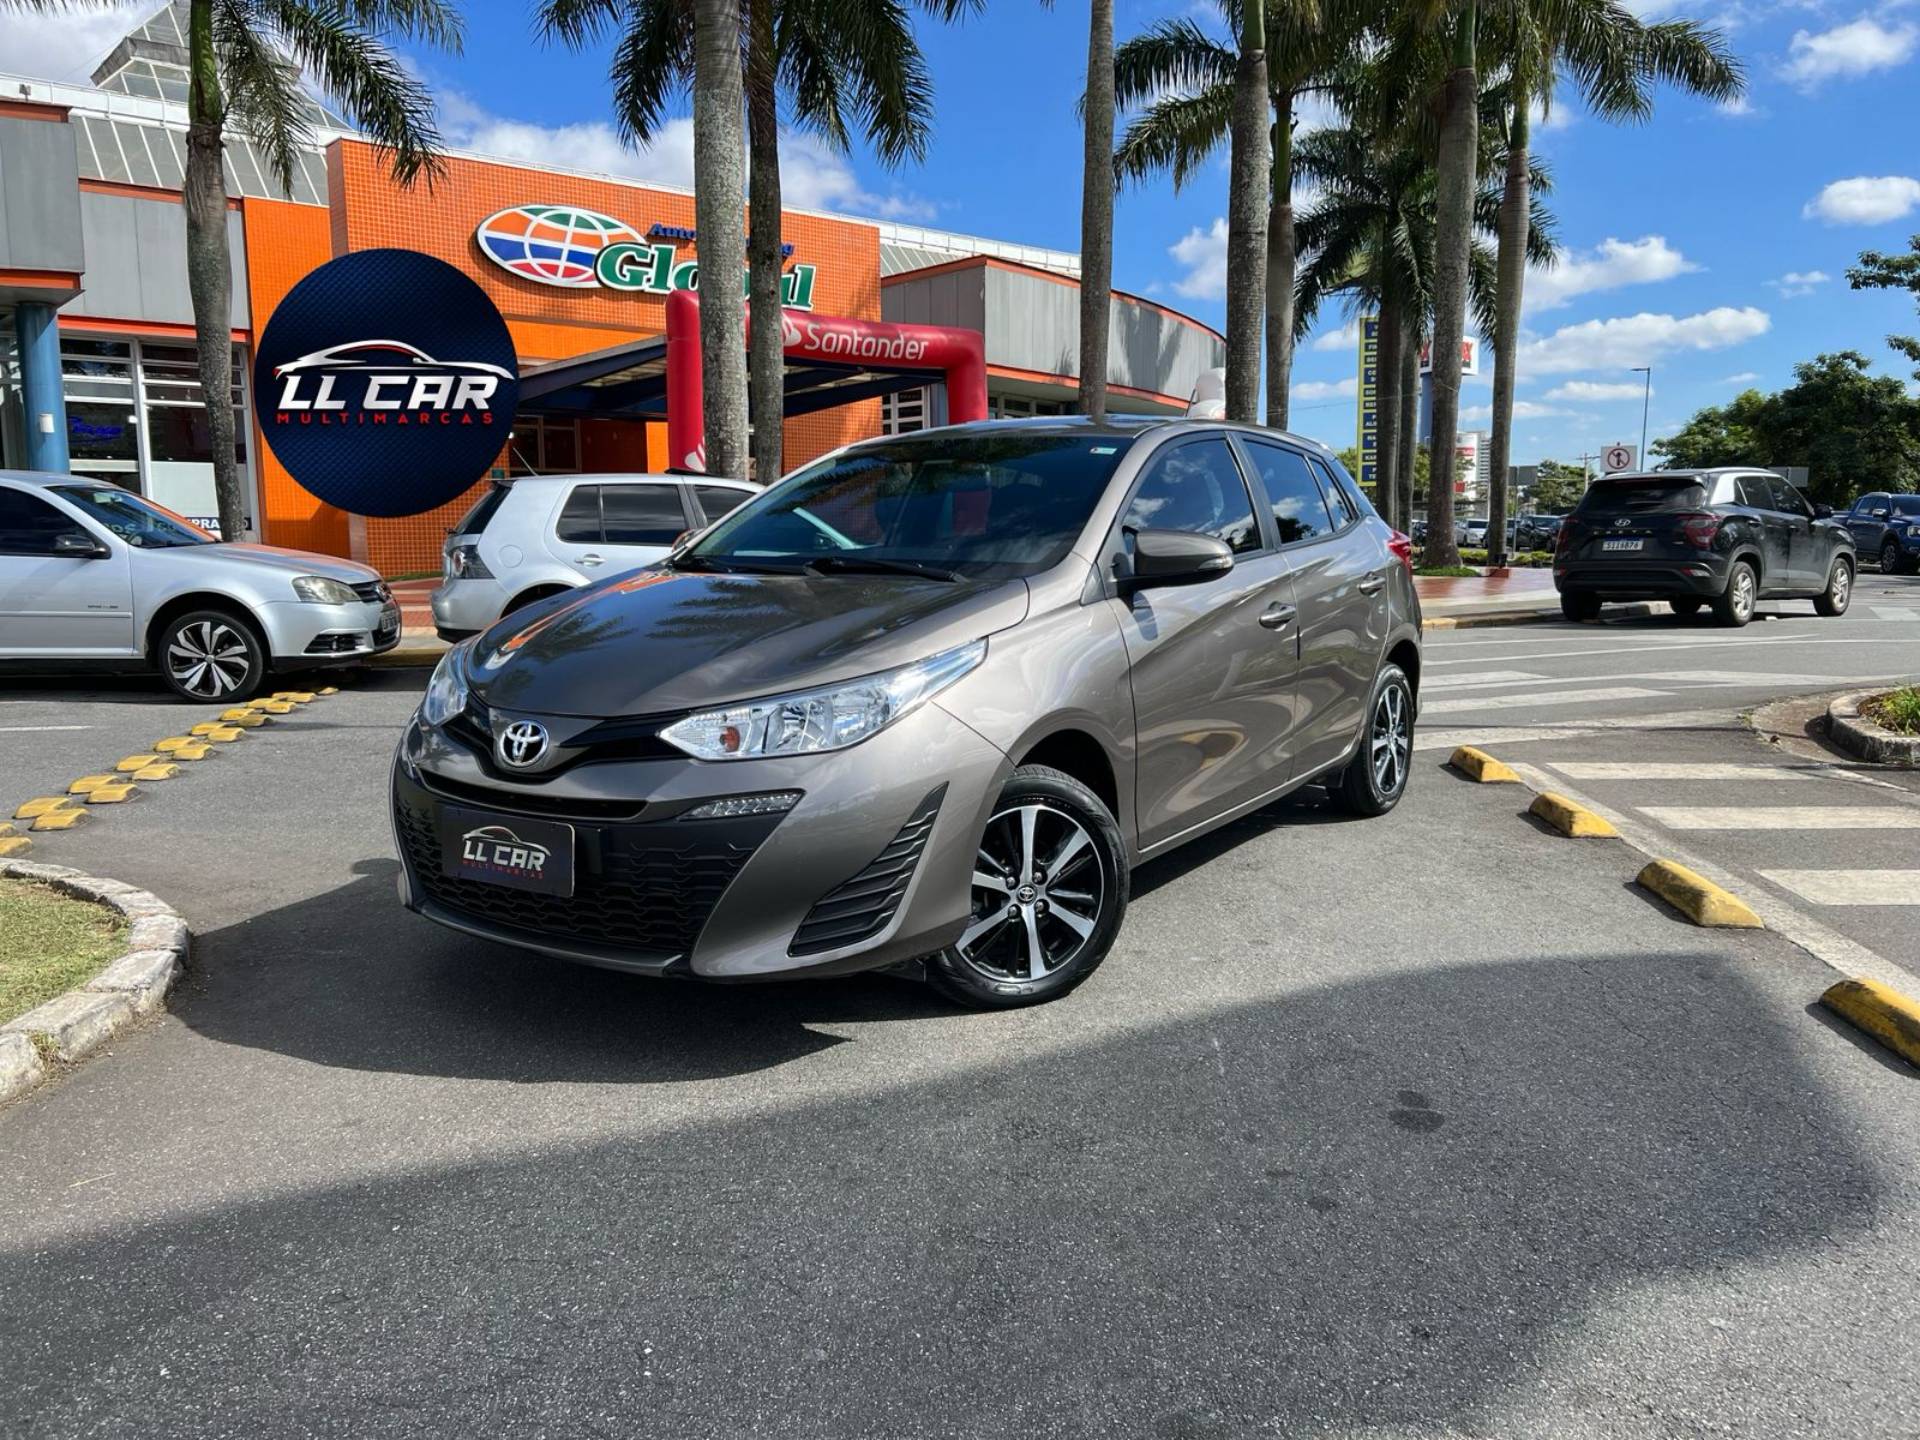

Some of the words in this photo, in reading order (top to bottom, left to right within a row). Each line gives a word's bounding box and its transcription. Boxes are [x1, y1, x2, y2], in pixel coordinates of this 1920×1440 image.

[595, 242, 817, 312] Glol
[804, 323, 929, 360] Santander
[463, 840, 488, 862] LL
[493, 845, 546, 872] CAR
